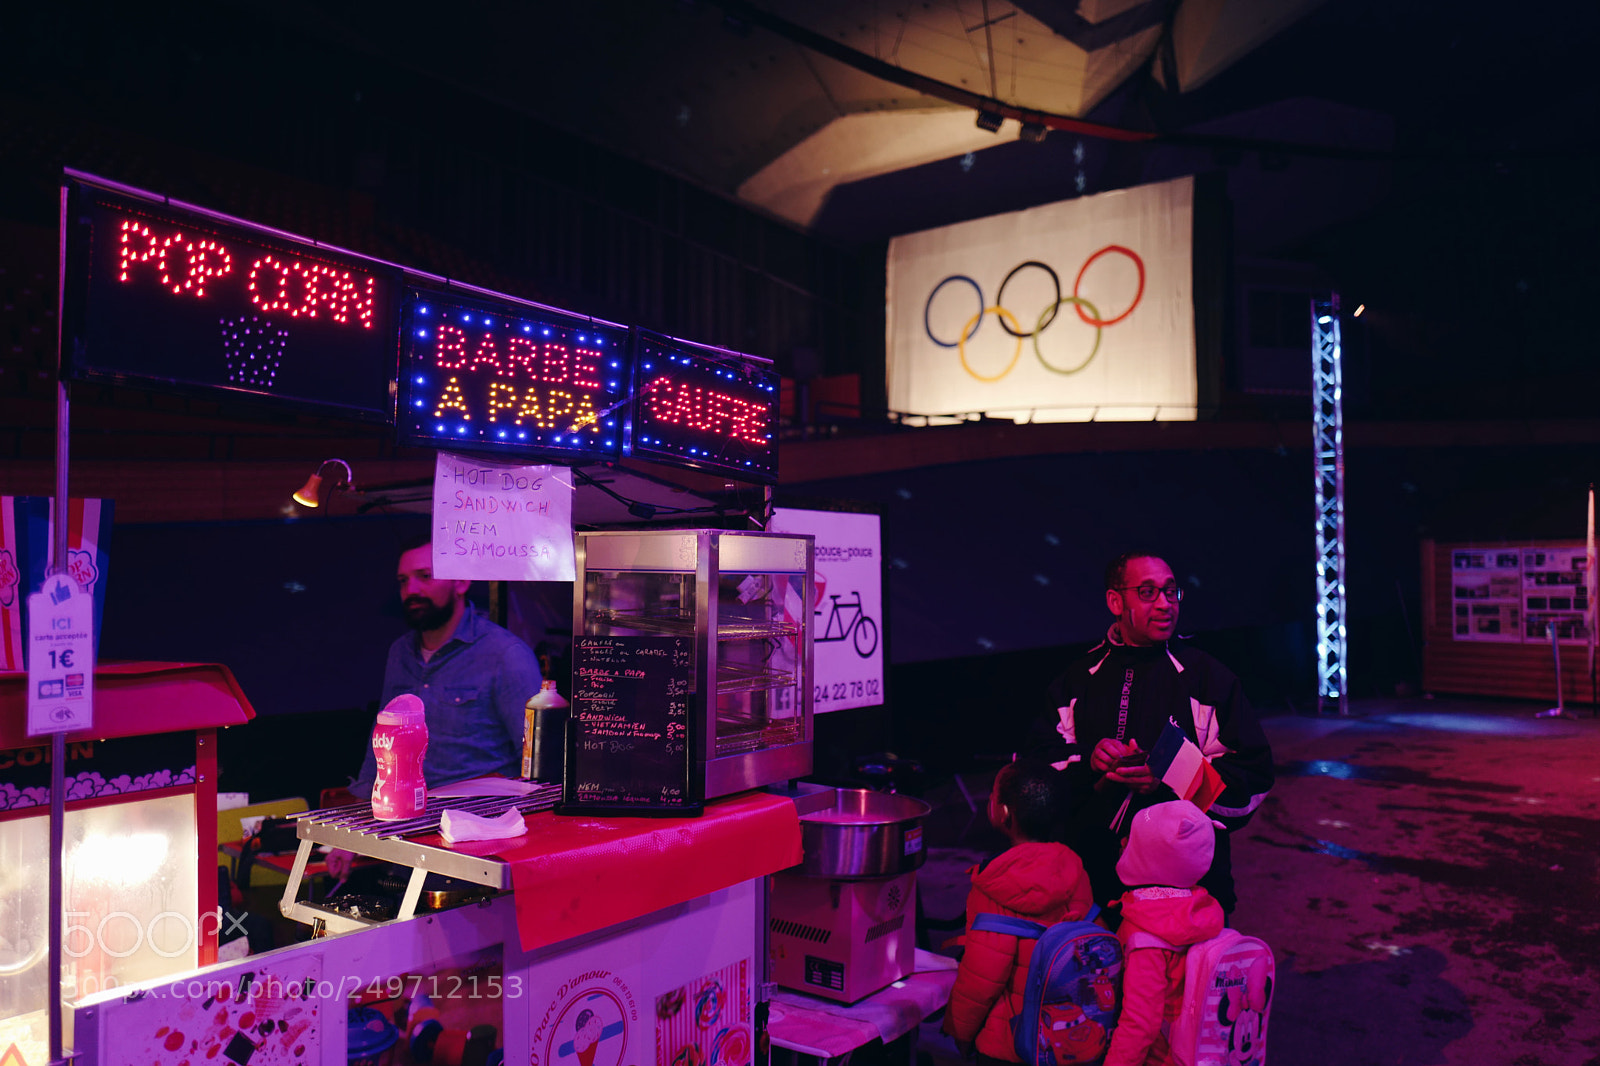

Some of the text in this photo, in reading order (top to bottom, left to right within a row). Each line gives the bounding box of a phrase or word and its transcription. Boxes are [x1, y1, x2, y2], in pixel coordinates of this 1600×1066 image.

[119, 220, 374, 328] POP CORN
[437, 325, 602, 388] BARBE
[434, 377, 599, 433] A PAPA
[651, 376, 767, 445] GAUFRE
[454, 466, 543, 491] HOT DOG
[454, 490, 550, 516] SANDWICH
[455, 520, 497, 536] NEM
[51, 618, 72, 630] ICI
[832, 683, 847, 700] 22
[850, 681, 864, 698] 78
[866, 679, 879, 696] 02
[577, 782, 600, 791] NEM
